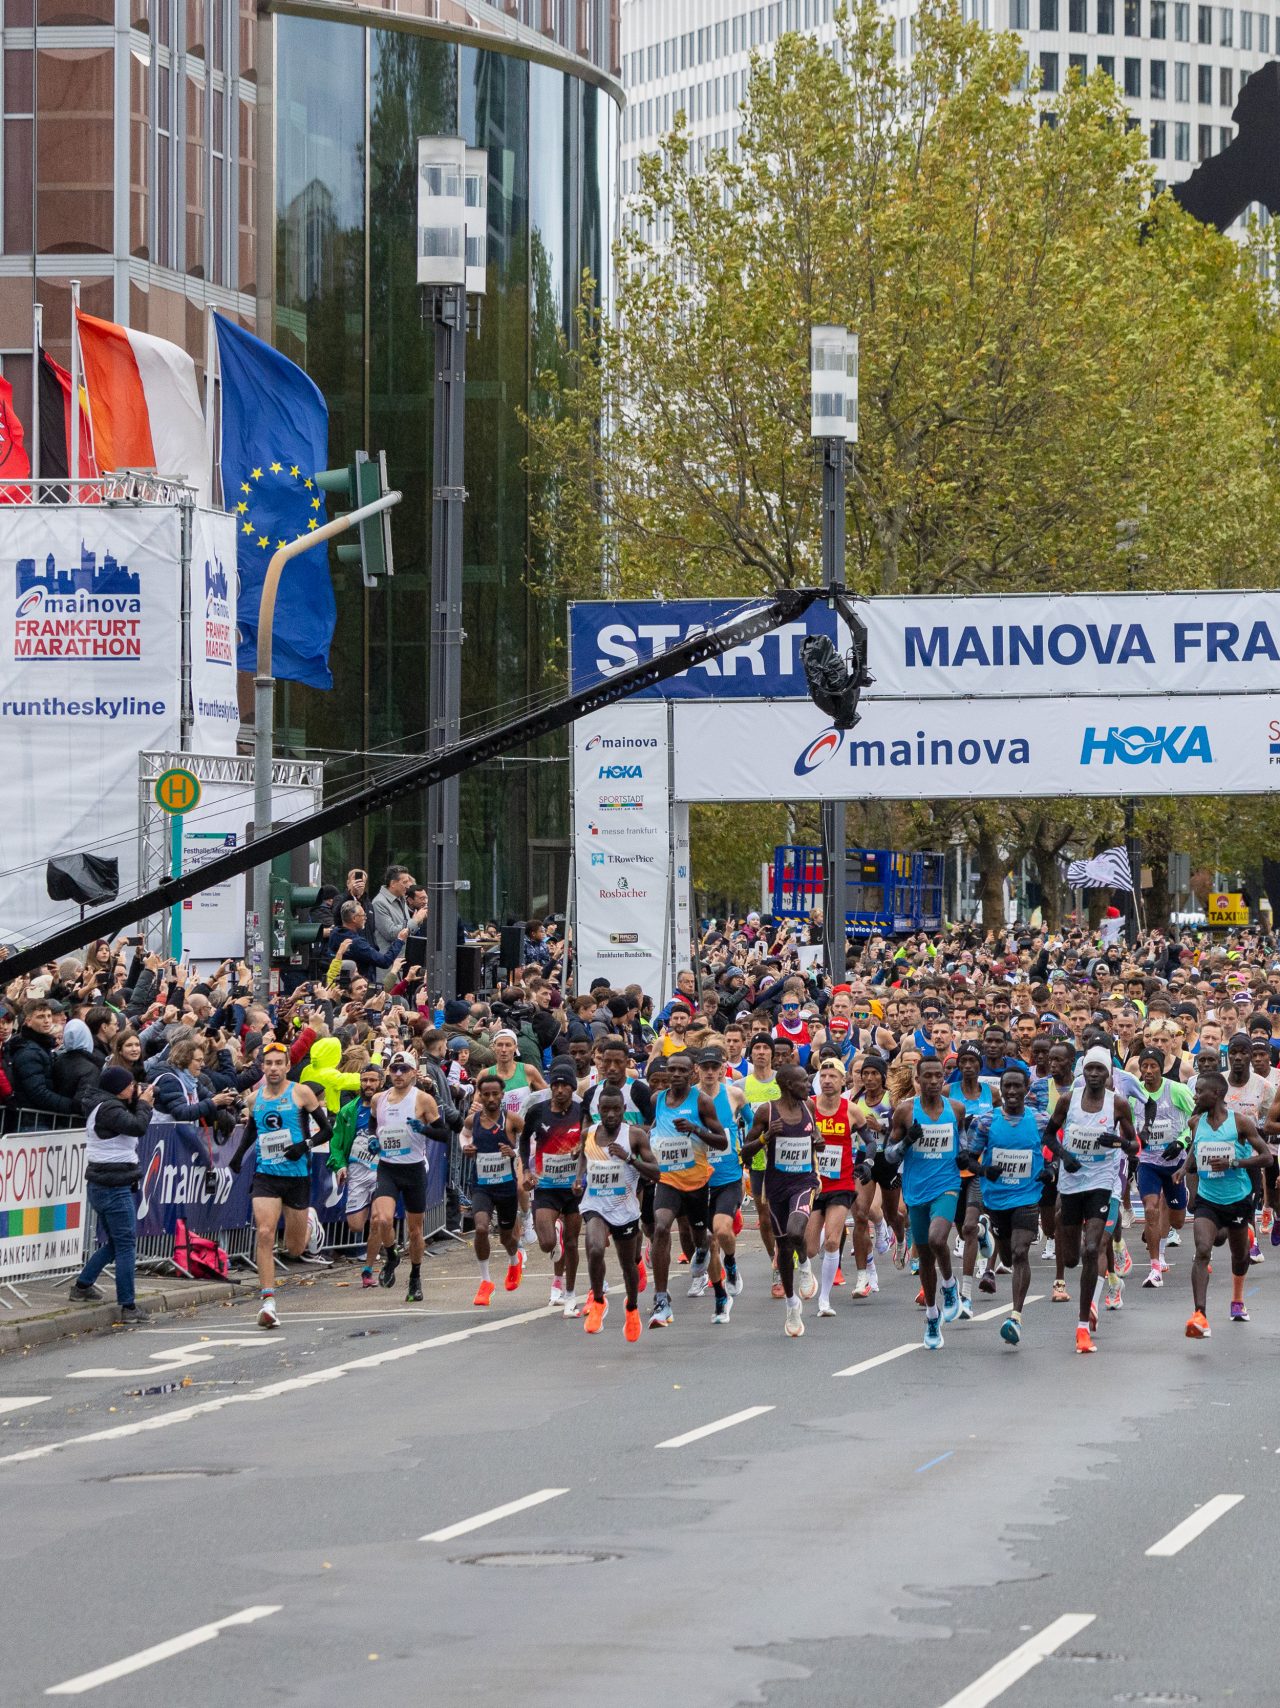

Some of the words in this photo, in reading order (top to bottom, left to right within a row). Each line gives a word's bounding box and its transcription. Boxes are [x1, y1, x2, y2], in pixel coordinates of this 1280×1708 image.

[45, 595, 140, 613] mainova
[15, 620, 141, 637] FRANKFURT
[206, 621, 231, 640] FRANKFURT
[14, 638, 141, 656] MARATHON
[206, 640, 233, 661] MARATHON
[904, 623, 1156, 667] MAINOVA
[2, 696, 166, 720] runtheskyline
[602, 736, 658, 749] mainova
[849, 730, 1030, 767] mainova
[1079, 725, 1213, 765] HOKA
[598, 765, 643, 779] HOKA
[169, 778, 186, 804] H
[598, 795, 644, 803] SPORTSTADT
[626, 827, 658, 835] frankfurt
[599, 888, 648, 899] Rosbacher
[1210, 911, 1236, 922] TAXI
[918, 1137, 940, 1148] PACE
[940, 1136, 949, 1147] M
[1150, 1131, 1165, 1140] ASIN
[383, 1138, 401, 1150] 5335
[1072, 1138, 1091, 1150] PACE
[661, 1149, 679, 1160] PACE
[680, 1147, 689, 1159] W
[780, 1149, 800, 1160] PACE
[801, 1149, 809, 1160] W
[482, 1163, 505, 1173] ALAZAR
[544, 1163, 577, 1174] GETACHEW
[830, 1157, 838, 1167] W
[1018, 1163, 1027, 1173] M
[160, 1152, 234, 1205] mainva
[591, 1173, 609, 1184] PACE
[611, 1173, 619, 1183] M
[44, 1241, 57, 1258] AM
[60, 1237, 80, 1257] MAIN
